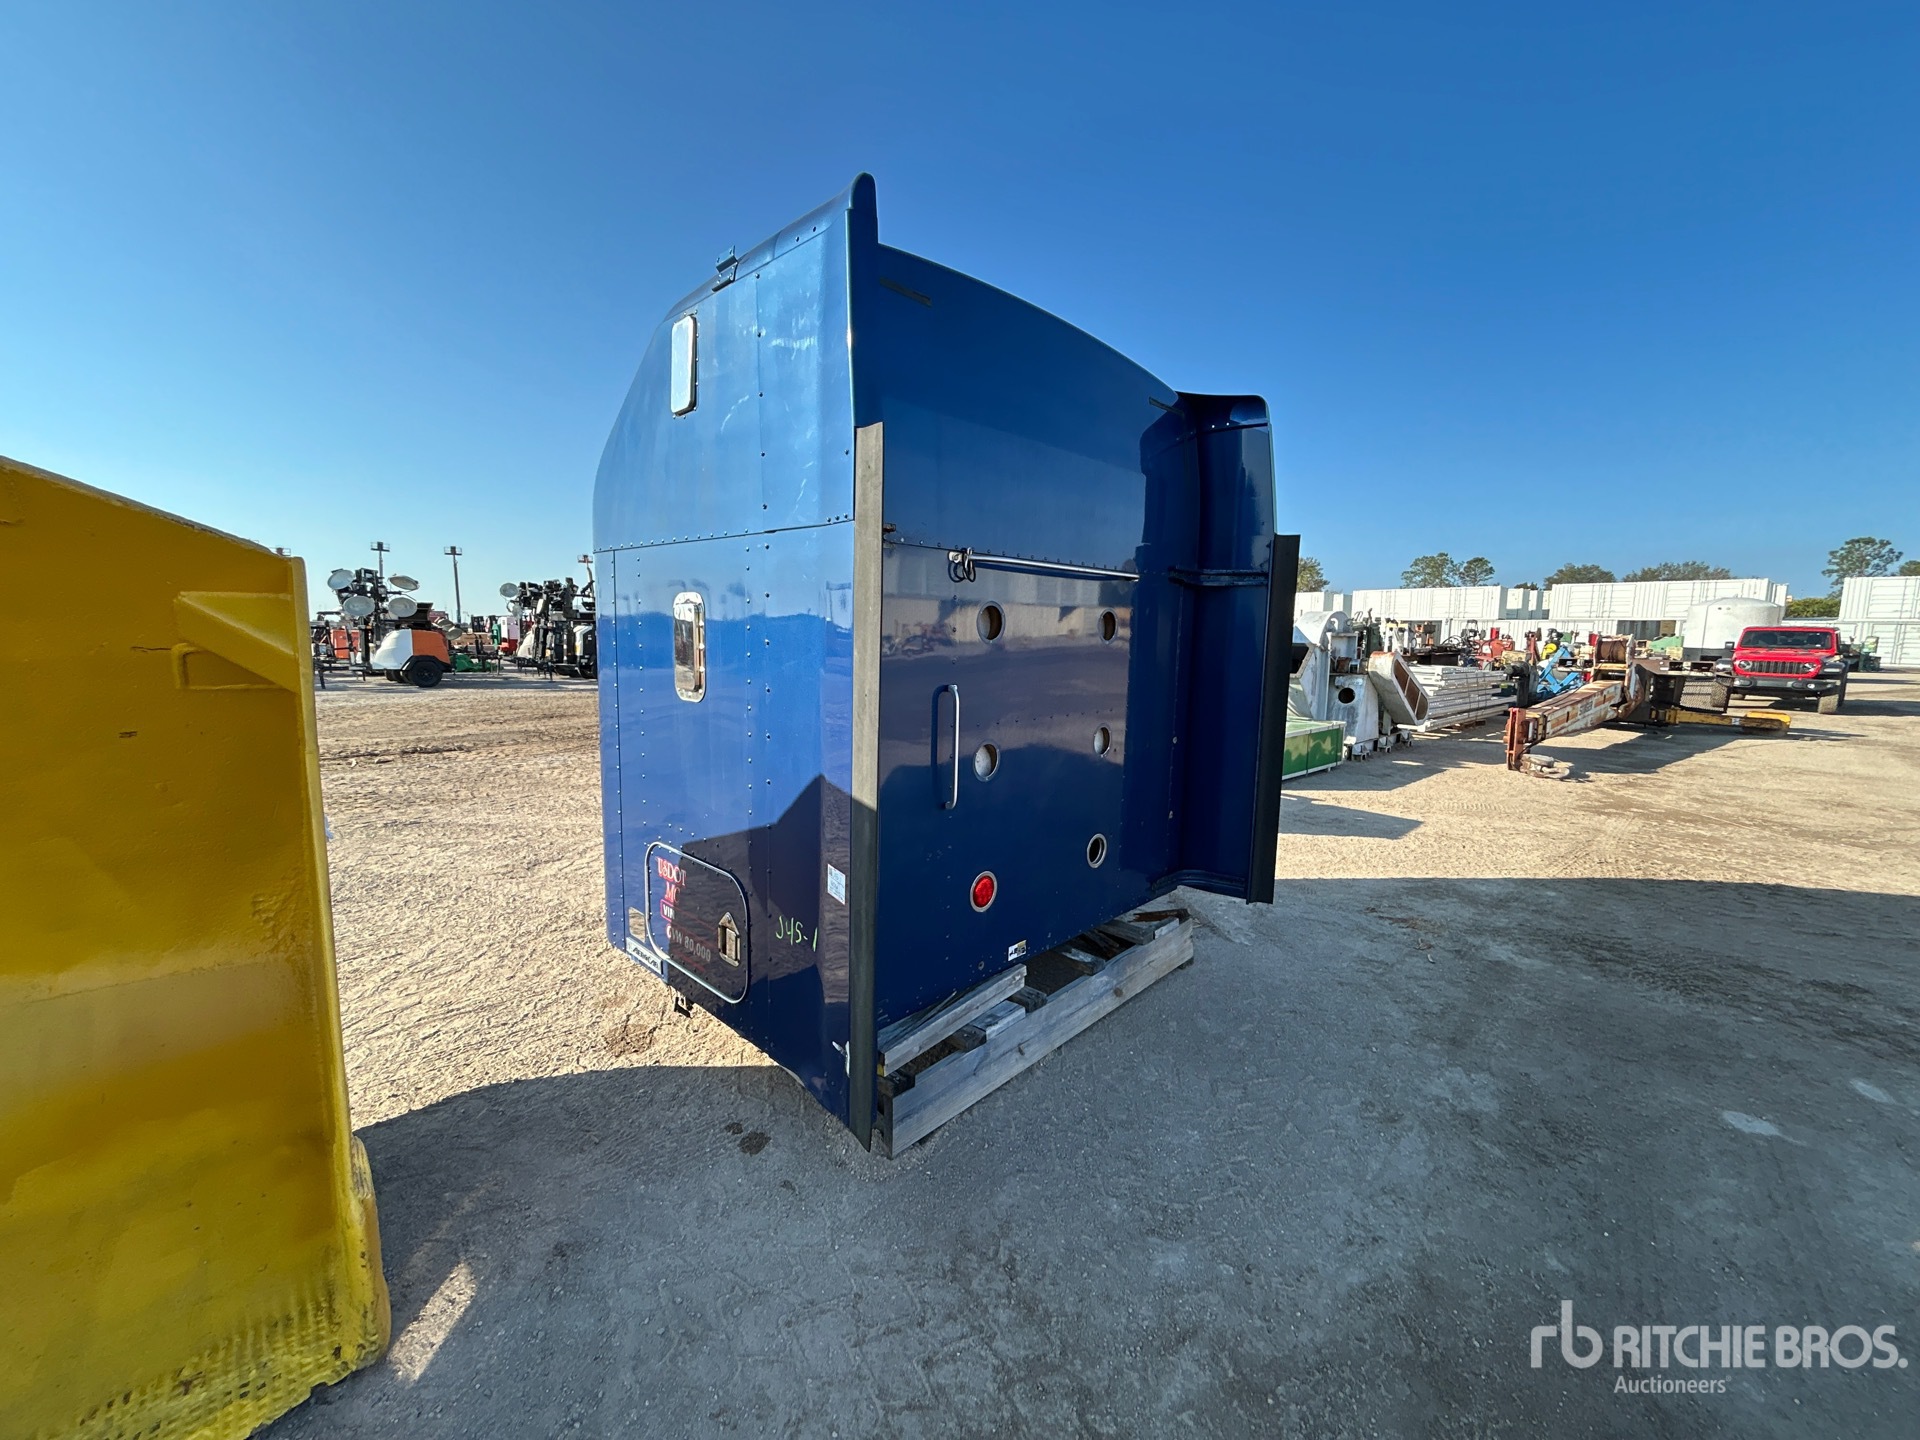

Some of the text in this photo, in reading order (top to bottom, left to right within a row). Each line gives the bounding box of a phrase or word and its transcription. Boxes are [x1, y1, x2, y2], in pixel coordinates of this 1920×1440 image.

[656, 856, 686, 887] USDOT
[665, 881, 680, 903] MC
[684, 935, 711, 963] 80,000
